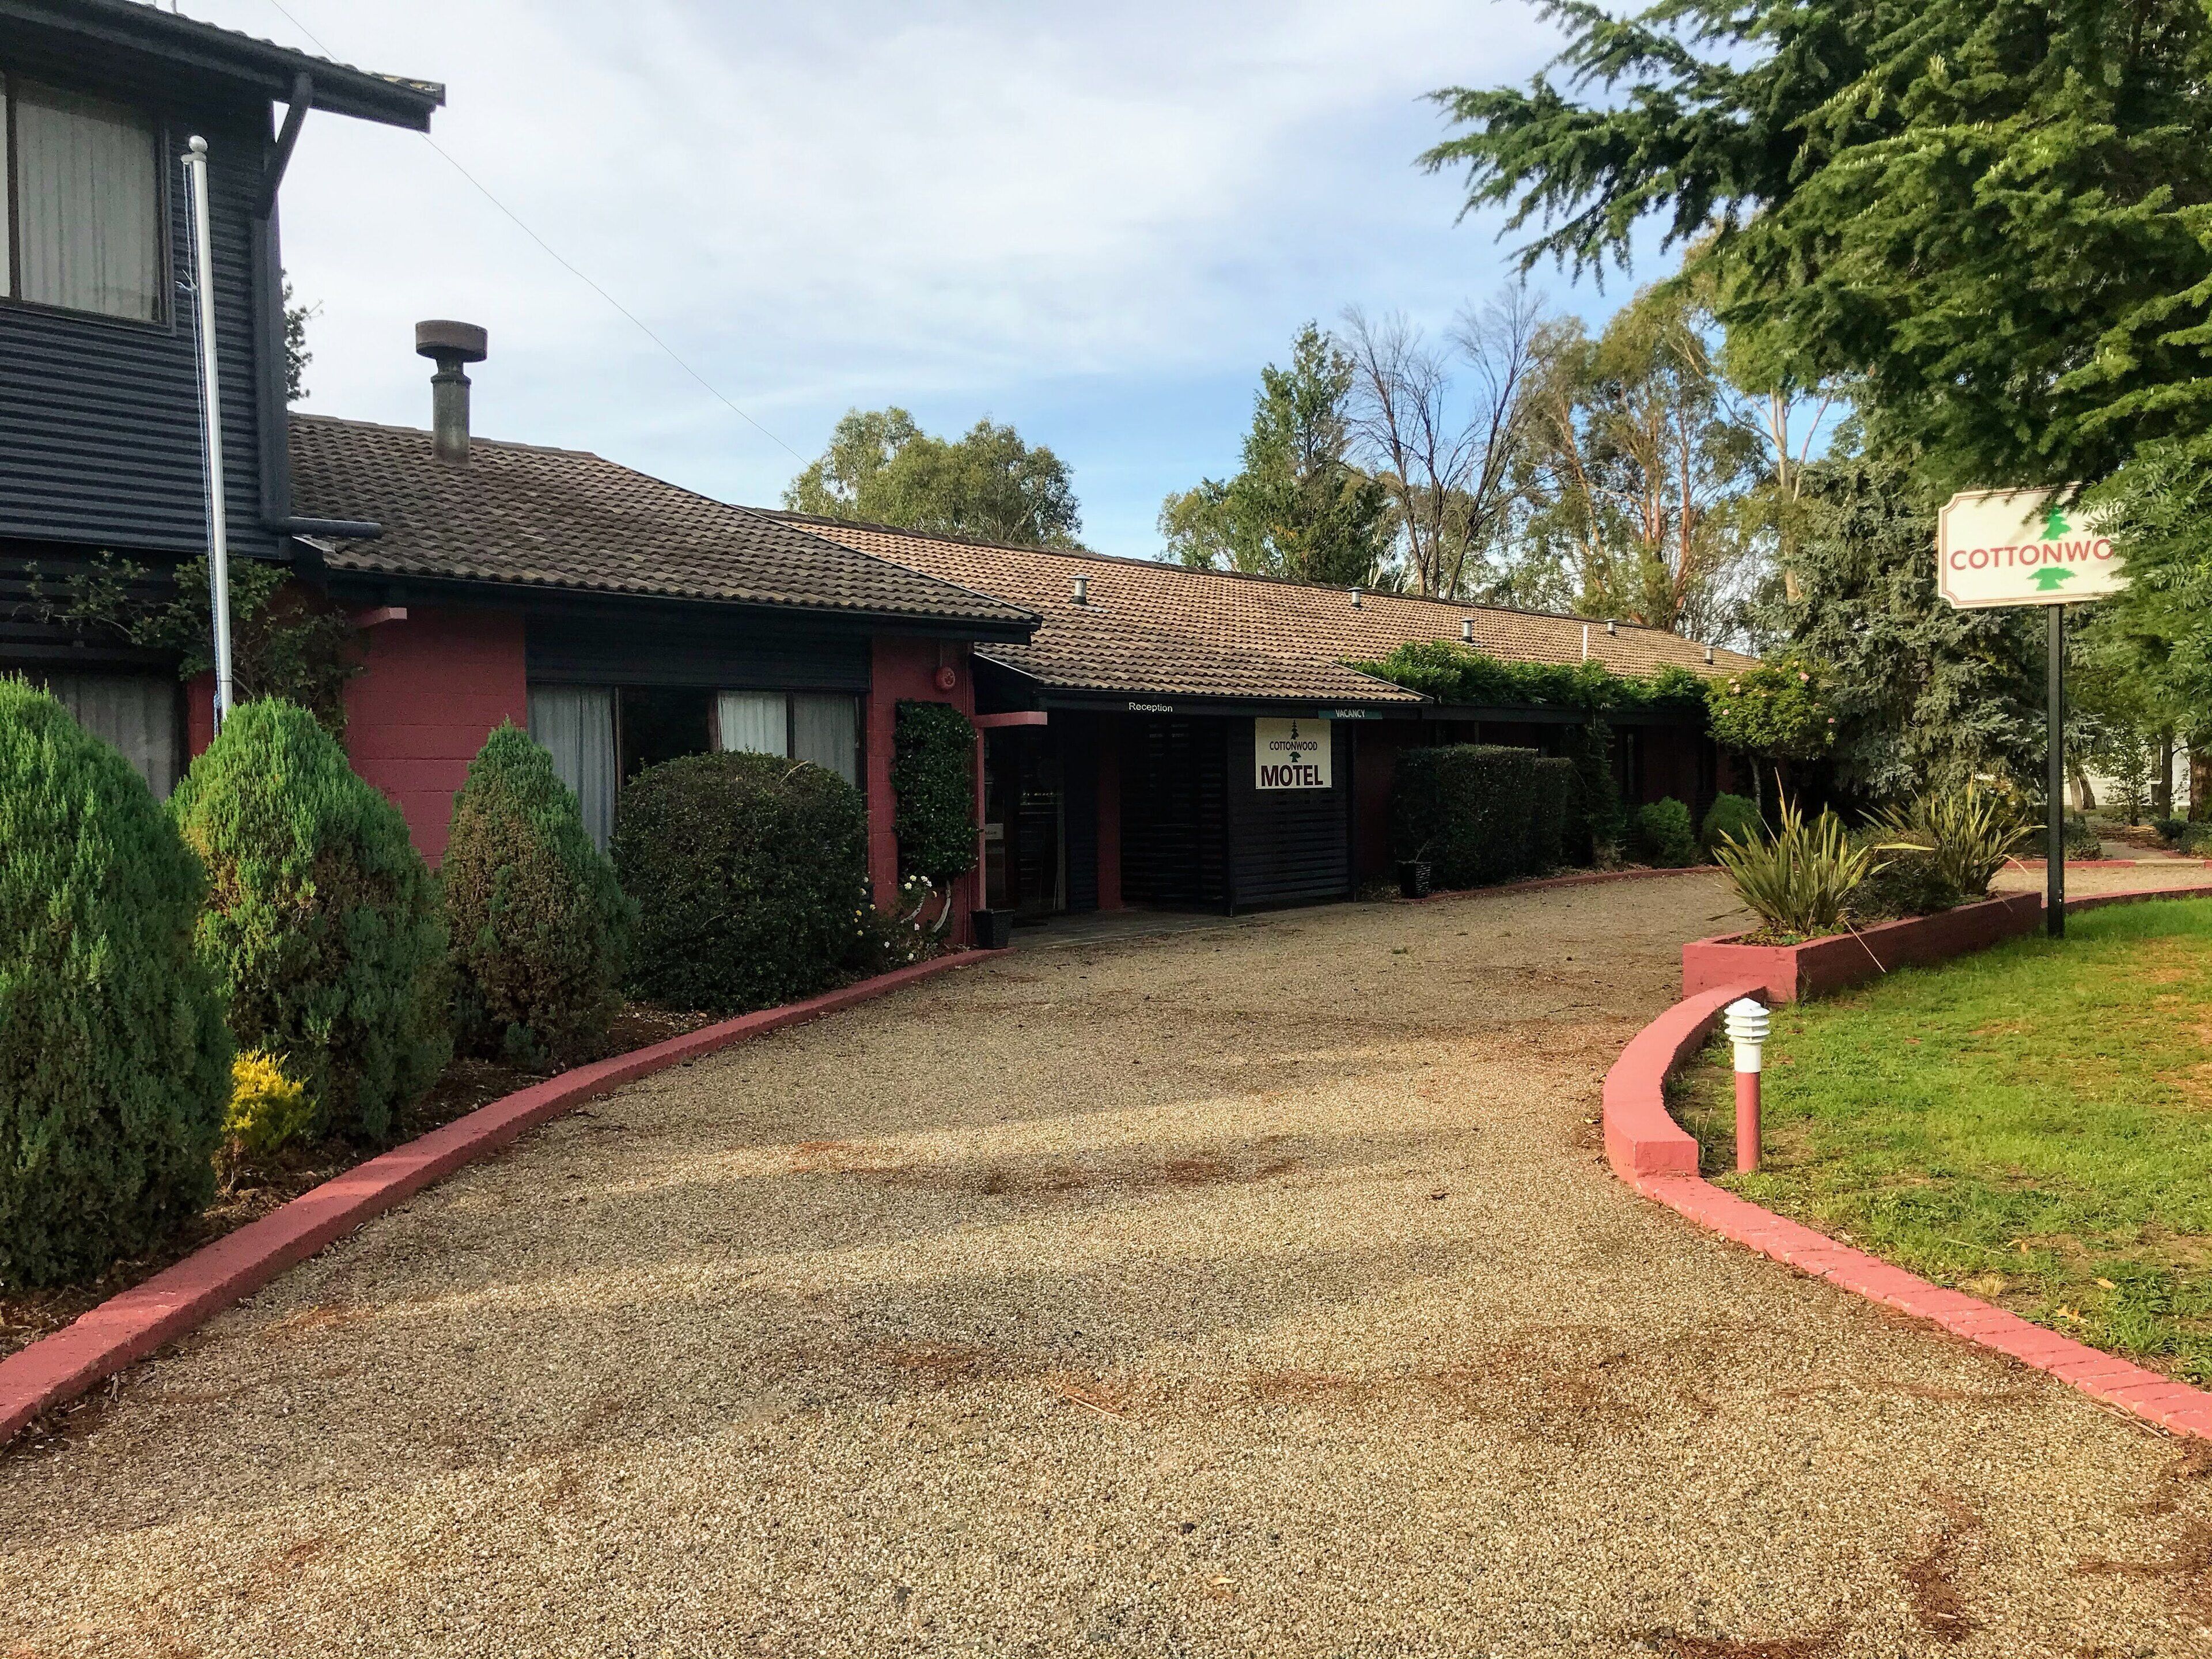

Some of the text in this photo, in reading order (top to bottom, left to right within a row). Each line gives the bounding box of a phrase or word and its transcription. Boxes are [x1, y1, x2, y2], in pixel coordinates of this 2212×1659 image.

[1128, 702, 1173, 713] Reception
[1335, 709, 1366, 719] VACANCY
[1269, 741, 1318, 751] COTTONWOOD
[1261, 764, 1324, 787] MOTEL
